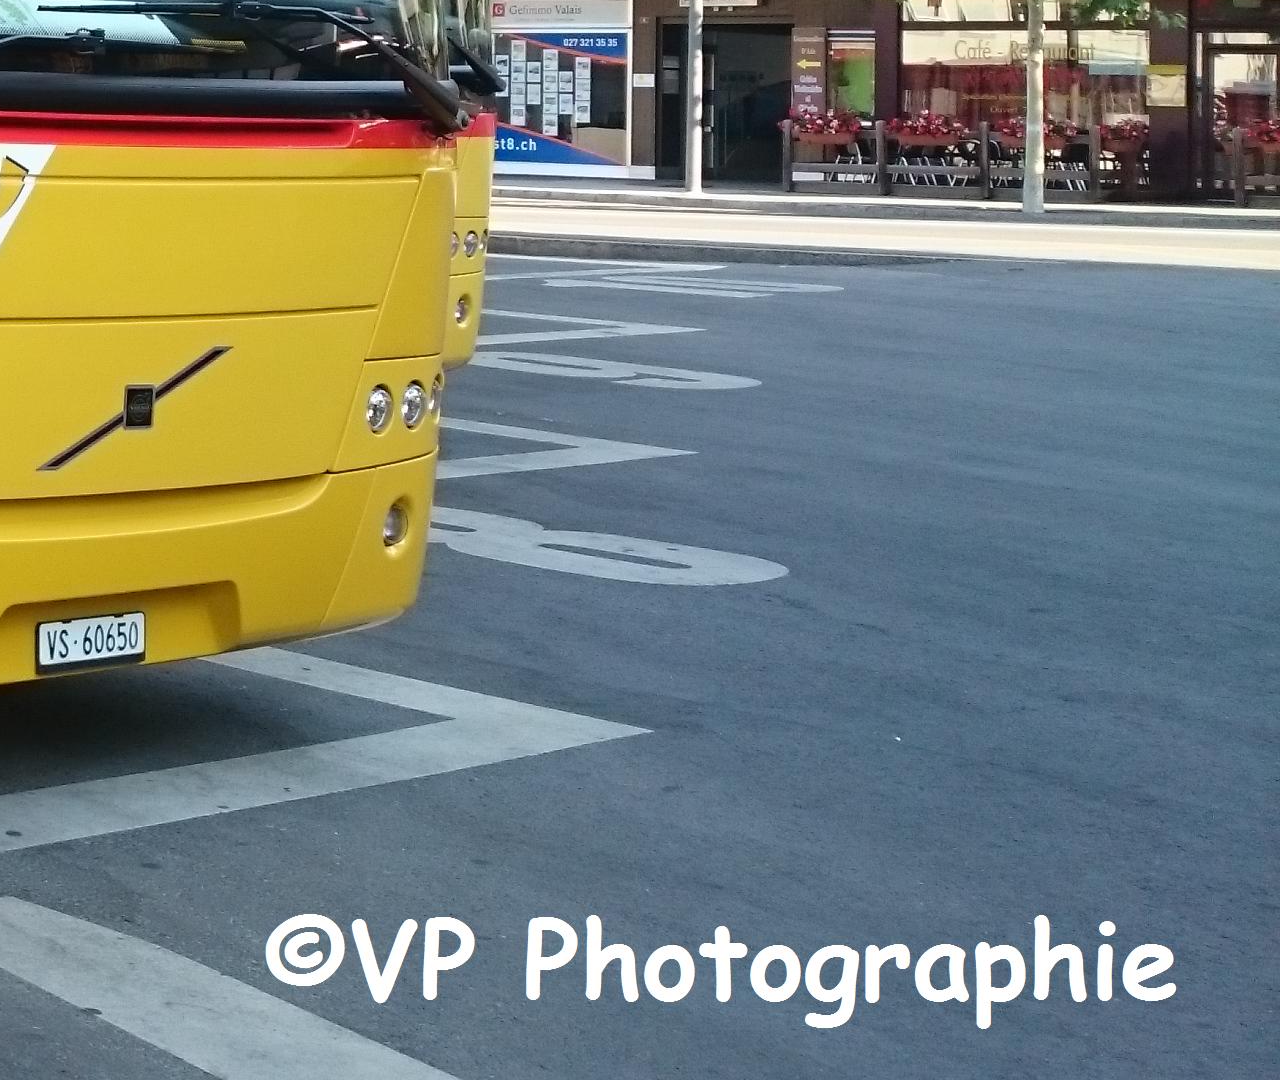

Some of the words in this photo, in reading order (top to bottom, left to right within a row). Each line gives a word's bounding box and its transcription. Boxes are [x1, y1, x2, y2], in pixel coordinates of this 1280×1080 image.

[555, 4, 582, 15] Valais
[563, 38, 578, 47] 027
[580, 38, 594, 47] 321
[595, 38, 606, 47] 35
[607, 38, 618, 47] 35
[954, 39, 991, 60] Café
[1010, 40, 1096, 61] Reaurant
